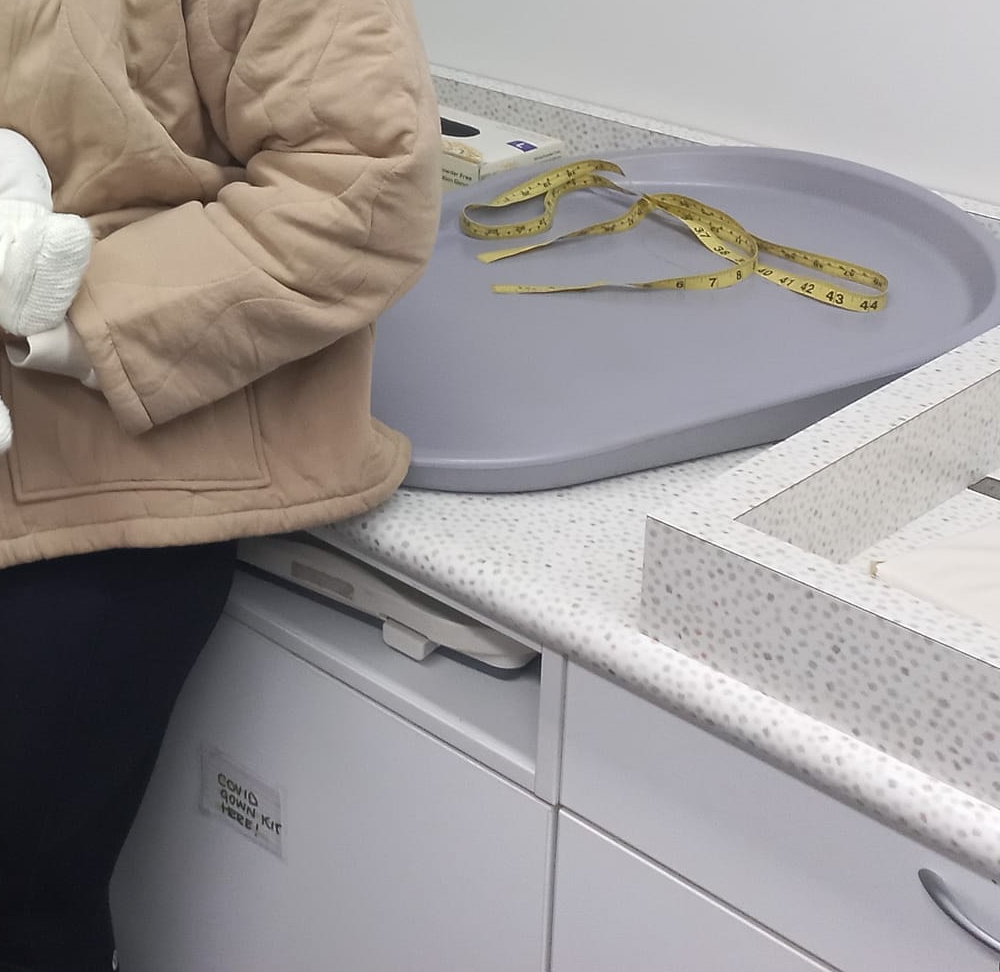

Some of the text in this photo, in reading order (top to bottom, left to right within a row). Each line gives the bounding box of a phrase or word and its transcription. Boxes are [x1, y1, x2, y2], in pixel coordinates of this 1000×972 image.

[709, 277, 717, 287] 7
[736, 270, 742, 280] 8
[800, 282, 815, 294] 42
[825, 291, 844, 304] 43
[860, 300, 878, 310] 44
[217, 772, 258, 807] COVID
[221, 801, 259, 837] HERE!
[261, 814, 282, 835] KIT
